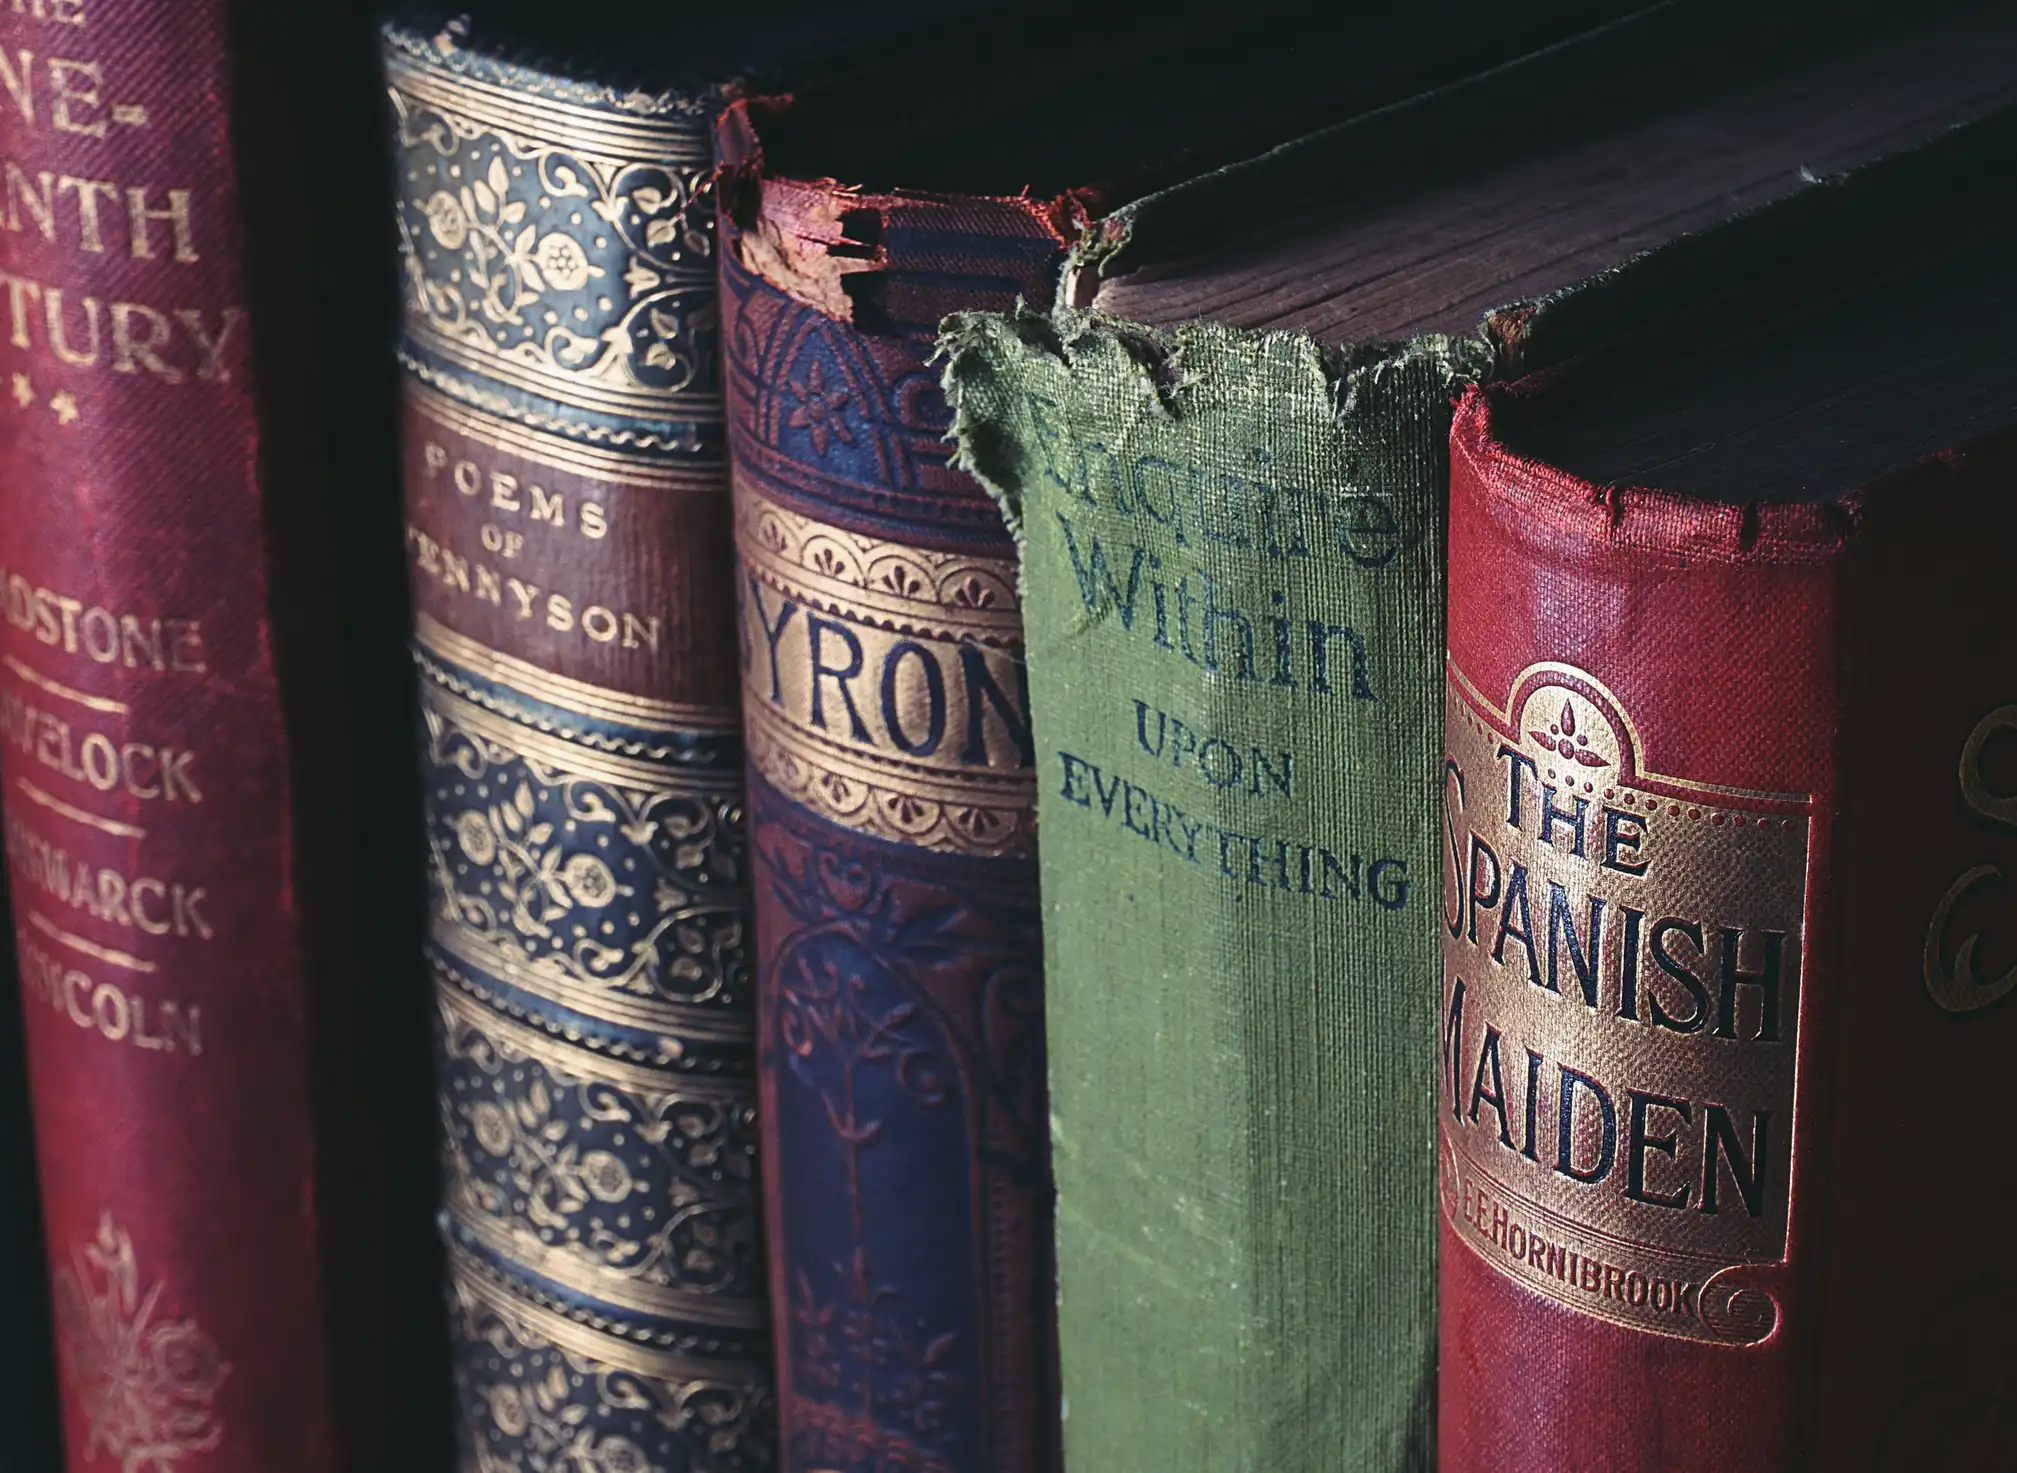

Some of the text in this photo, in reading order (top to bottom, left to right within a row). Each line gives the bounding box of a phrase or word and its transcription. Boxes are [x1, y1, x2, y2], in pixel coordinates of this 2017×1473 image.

[0, 161, 199, 262] NTH
[425, 441, 608, 539] POEMS
[480, 522, 524, 558] OF
[0, 567, 206, 674] DSTONE
[1056, 511, 1383, 701] Within
[738, 560, 1035, 769] YRON
[1133, 699, 1293, 798] UPON
[1496, 745, 1652, 876] THE
[1444, 753, 1786, 1042] SPANISH
